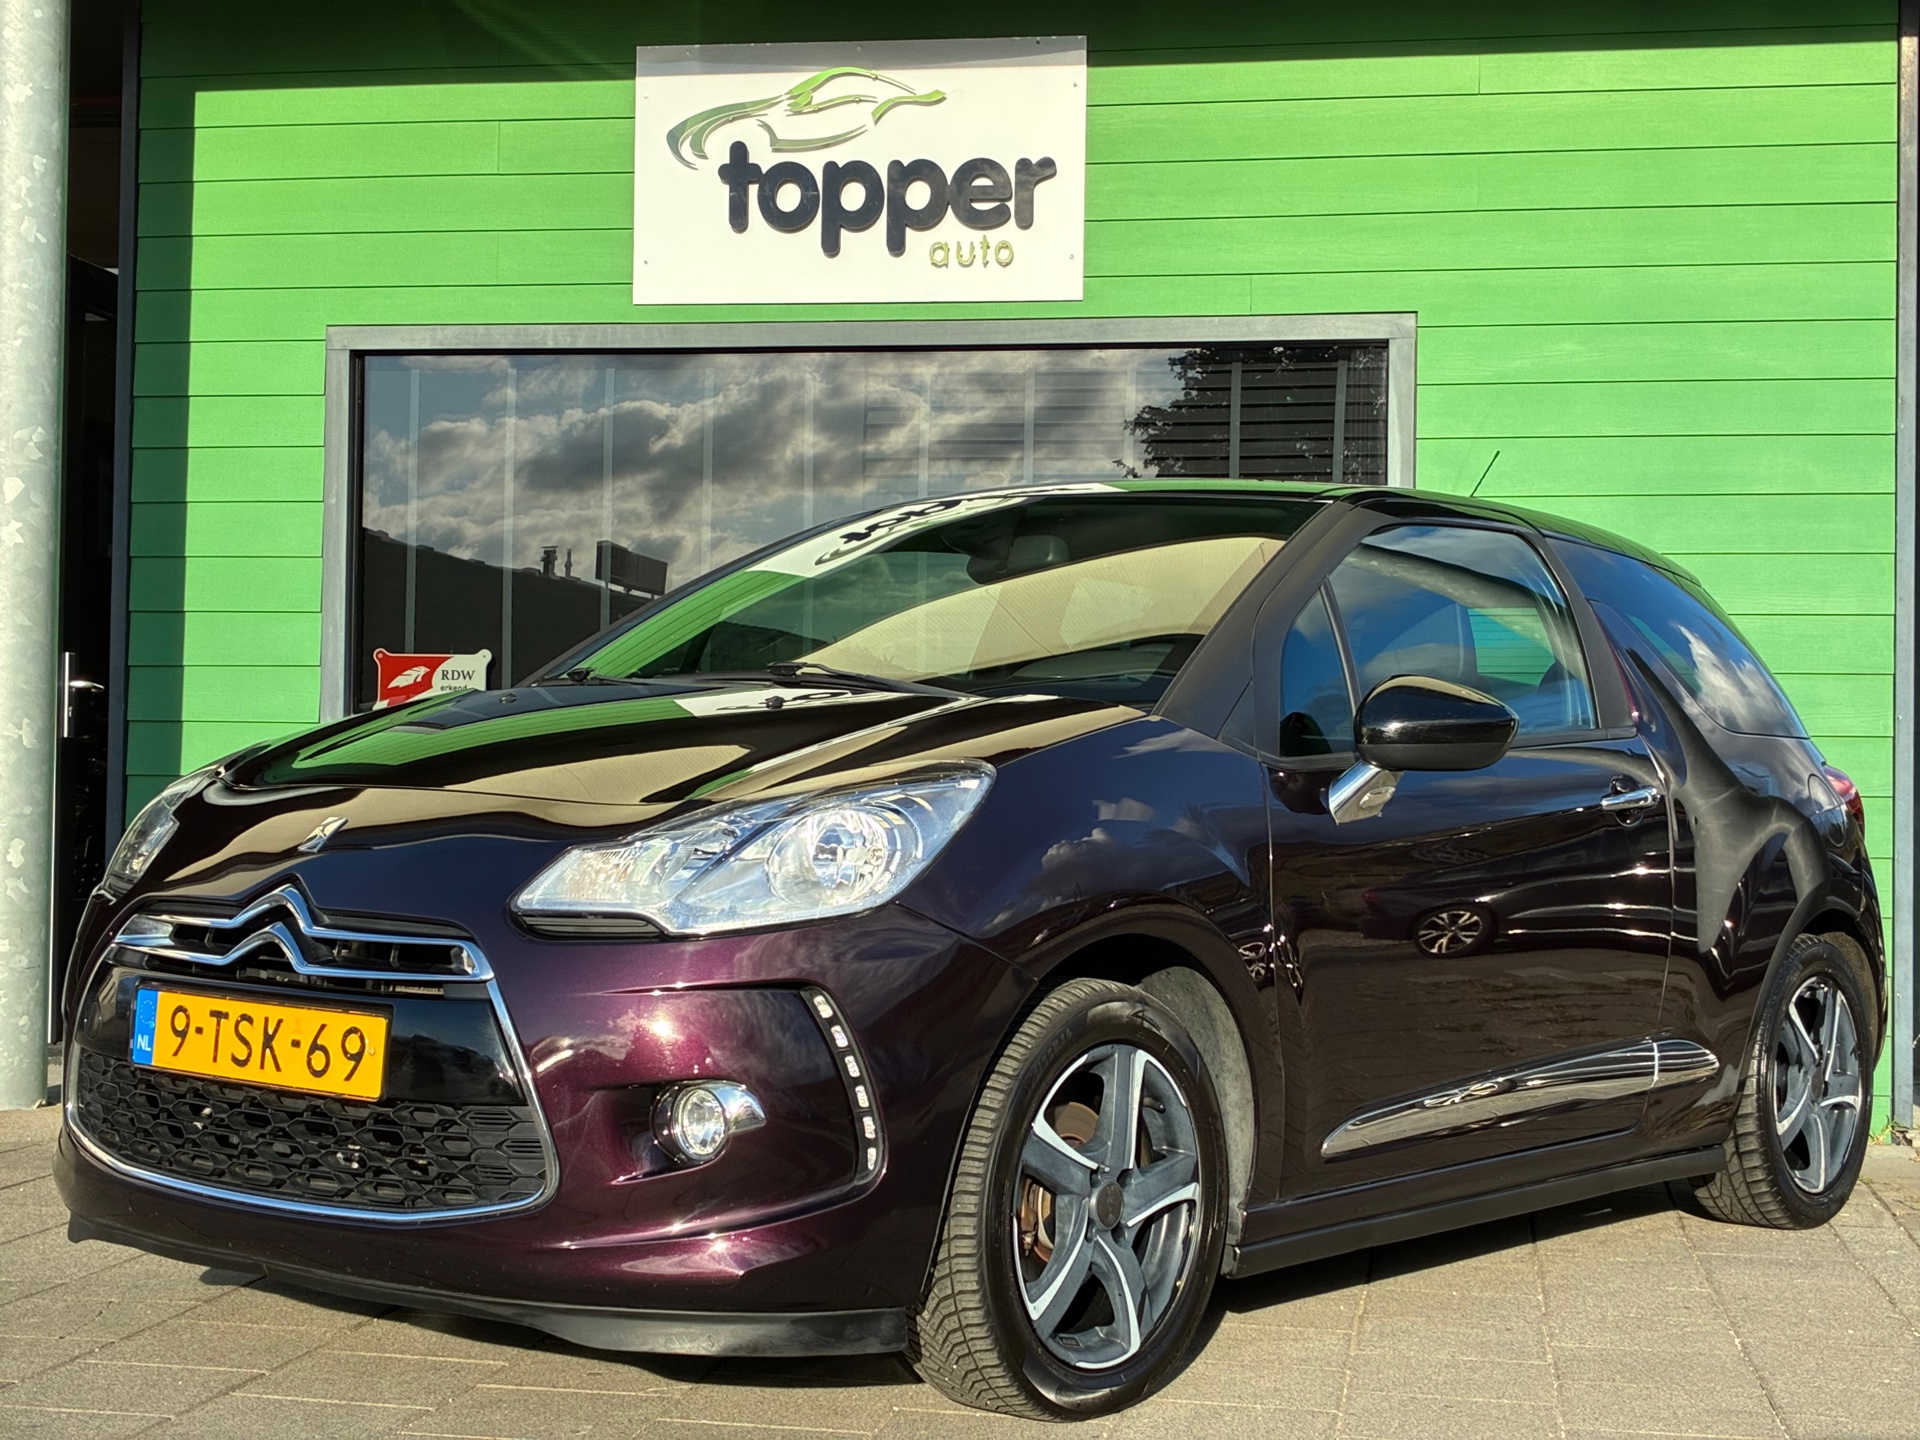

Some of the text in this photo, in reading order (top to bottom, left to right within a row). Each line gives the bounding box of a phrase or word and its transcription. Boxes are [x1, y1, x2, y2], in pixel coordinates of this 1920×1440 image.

[718, 140, 1057, 257] topper
[929, 235, 1014, 268] auto
[441, 669, 475, 681] RDW
[137, 1033, 151, 1051] NL
[170, 1005, 367, 1082] 9-TSK-69
